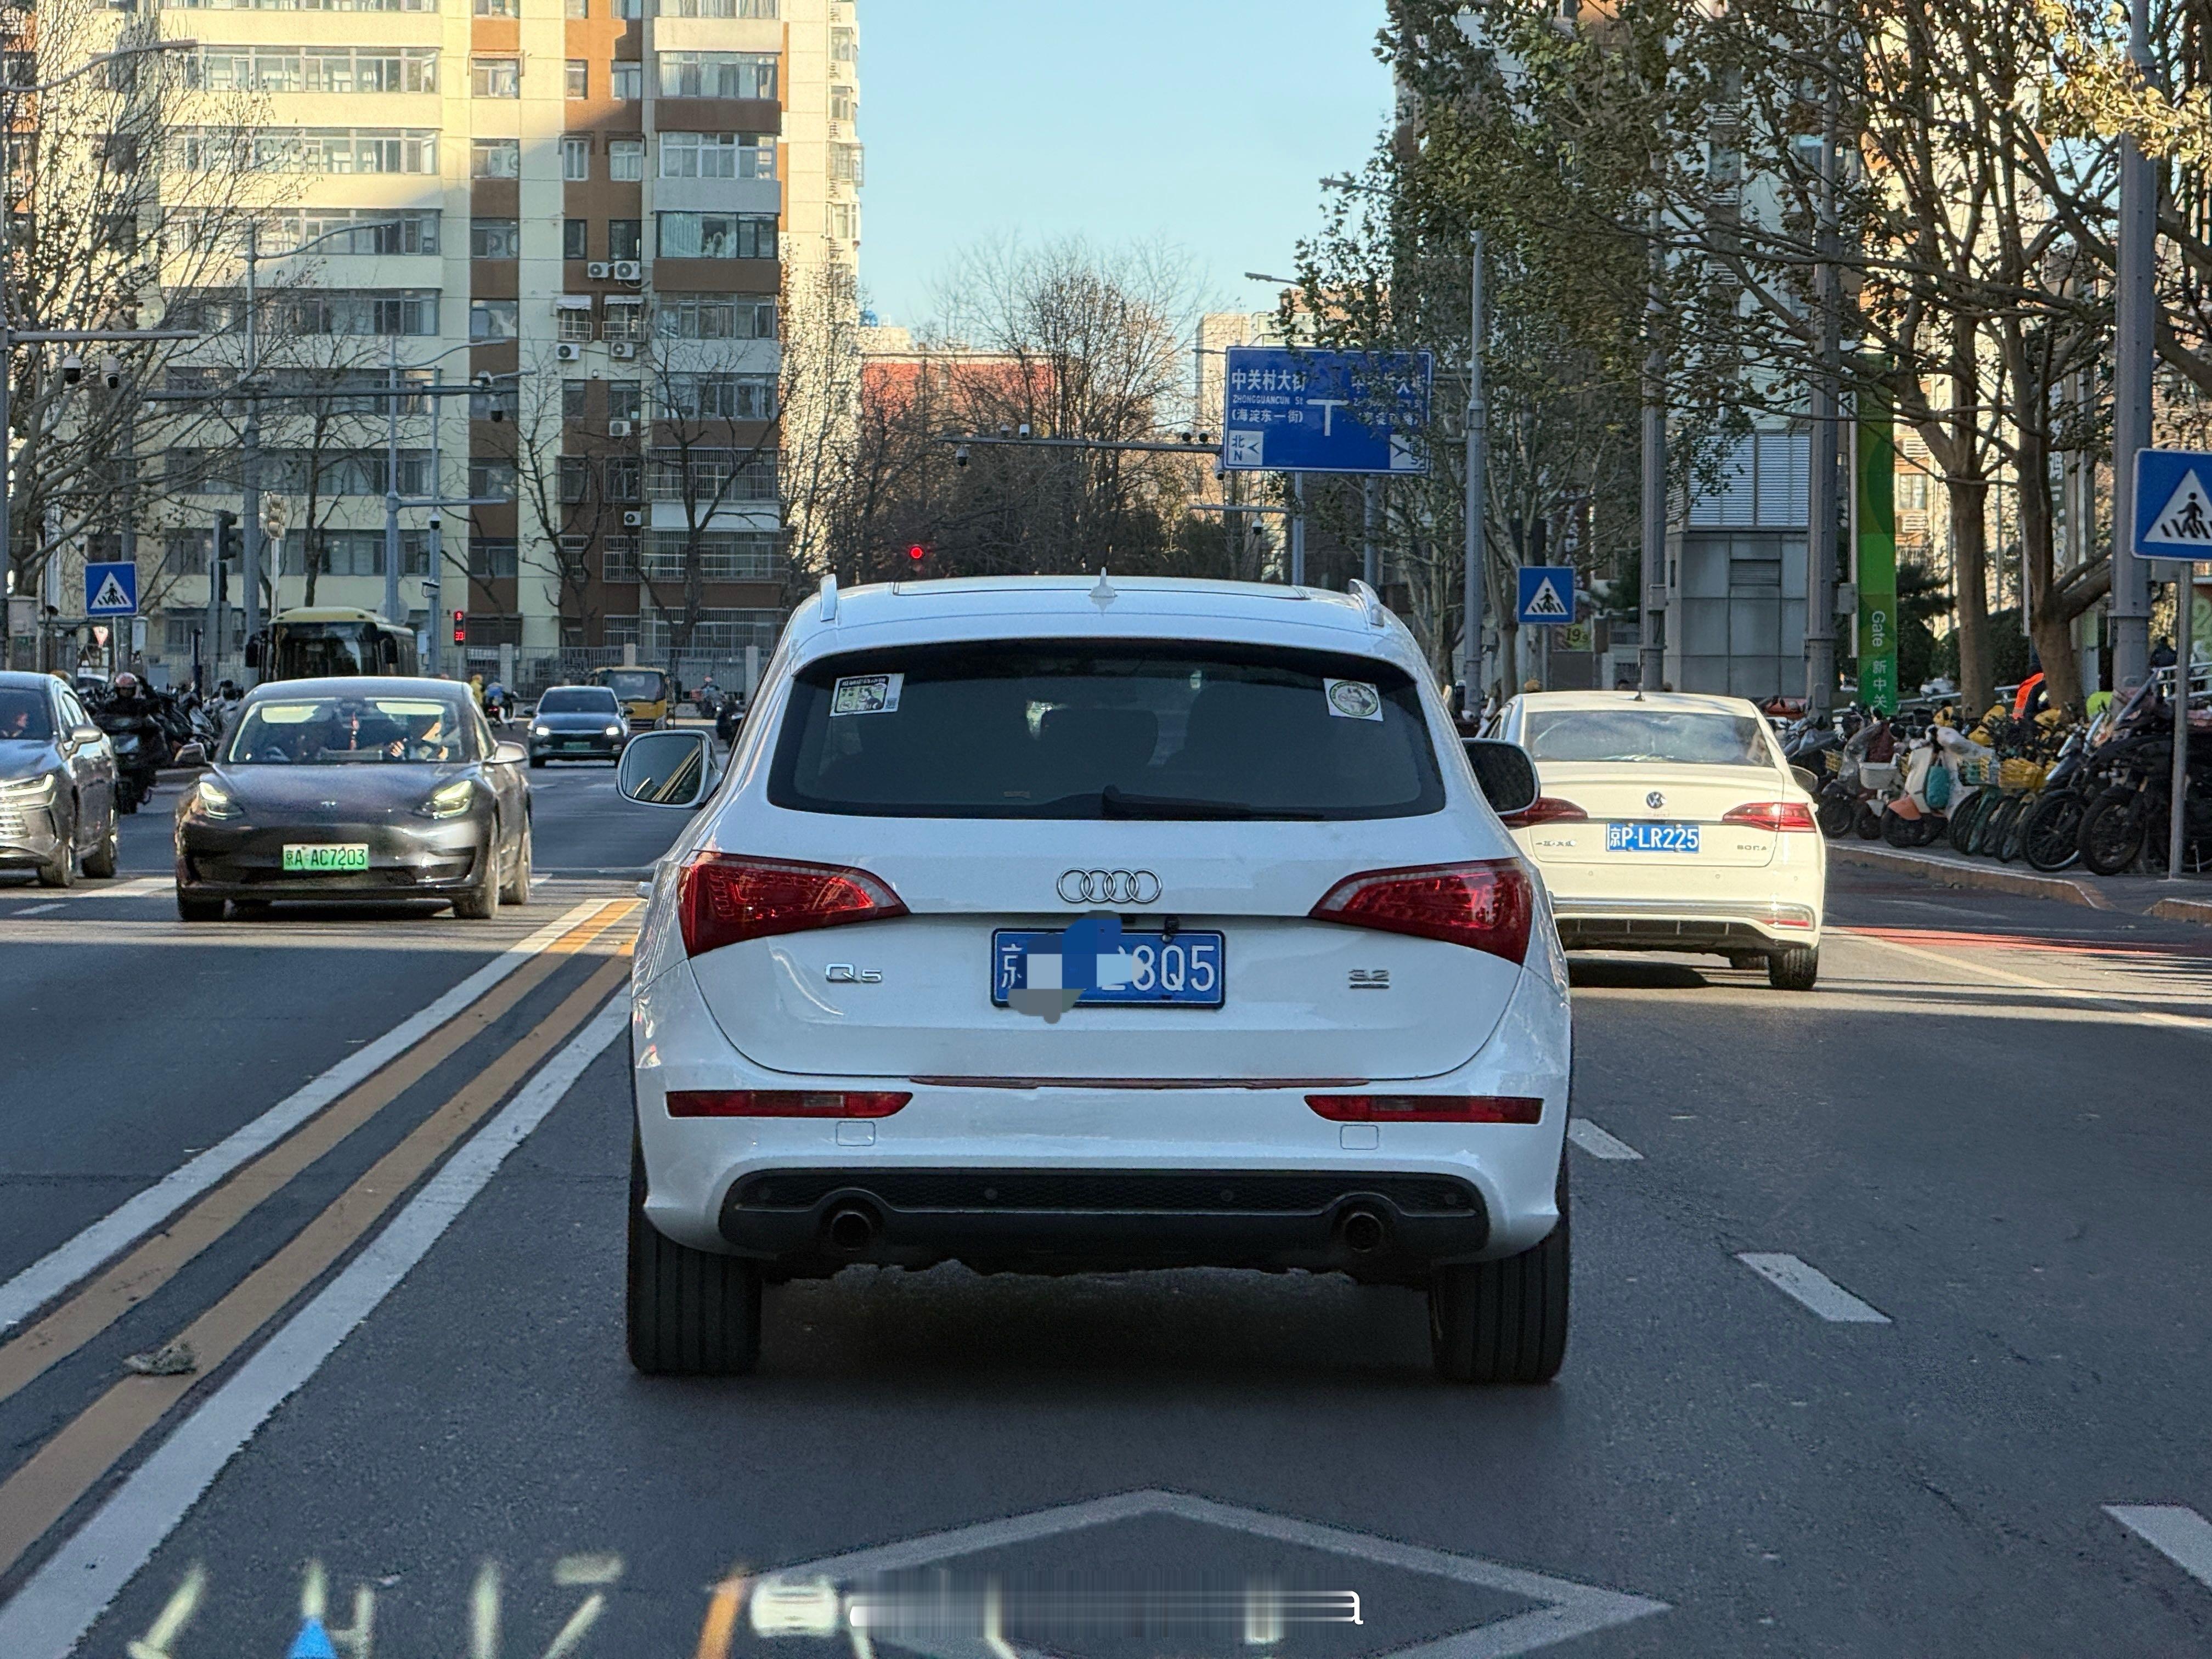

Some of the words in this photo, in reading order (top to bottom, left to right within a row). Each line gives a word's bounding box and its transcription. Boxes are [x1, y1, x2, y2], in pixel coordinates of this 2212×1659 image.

[1232, 368, 1306, 391] 中关村大街
[1233, 394, 1290, 404] ZHONGGUANCUN
[1232, 435, 1245, 448] 北
[1234, 450, 1243, 461] N
[1871, 610, 1886, 647] Gate
[1872, 660, 1887, 708] 新中关
[825, 963, 882, 983] Q5
